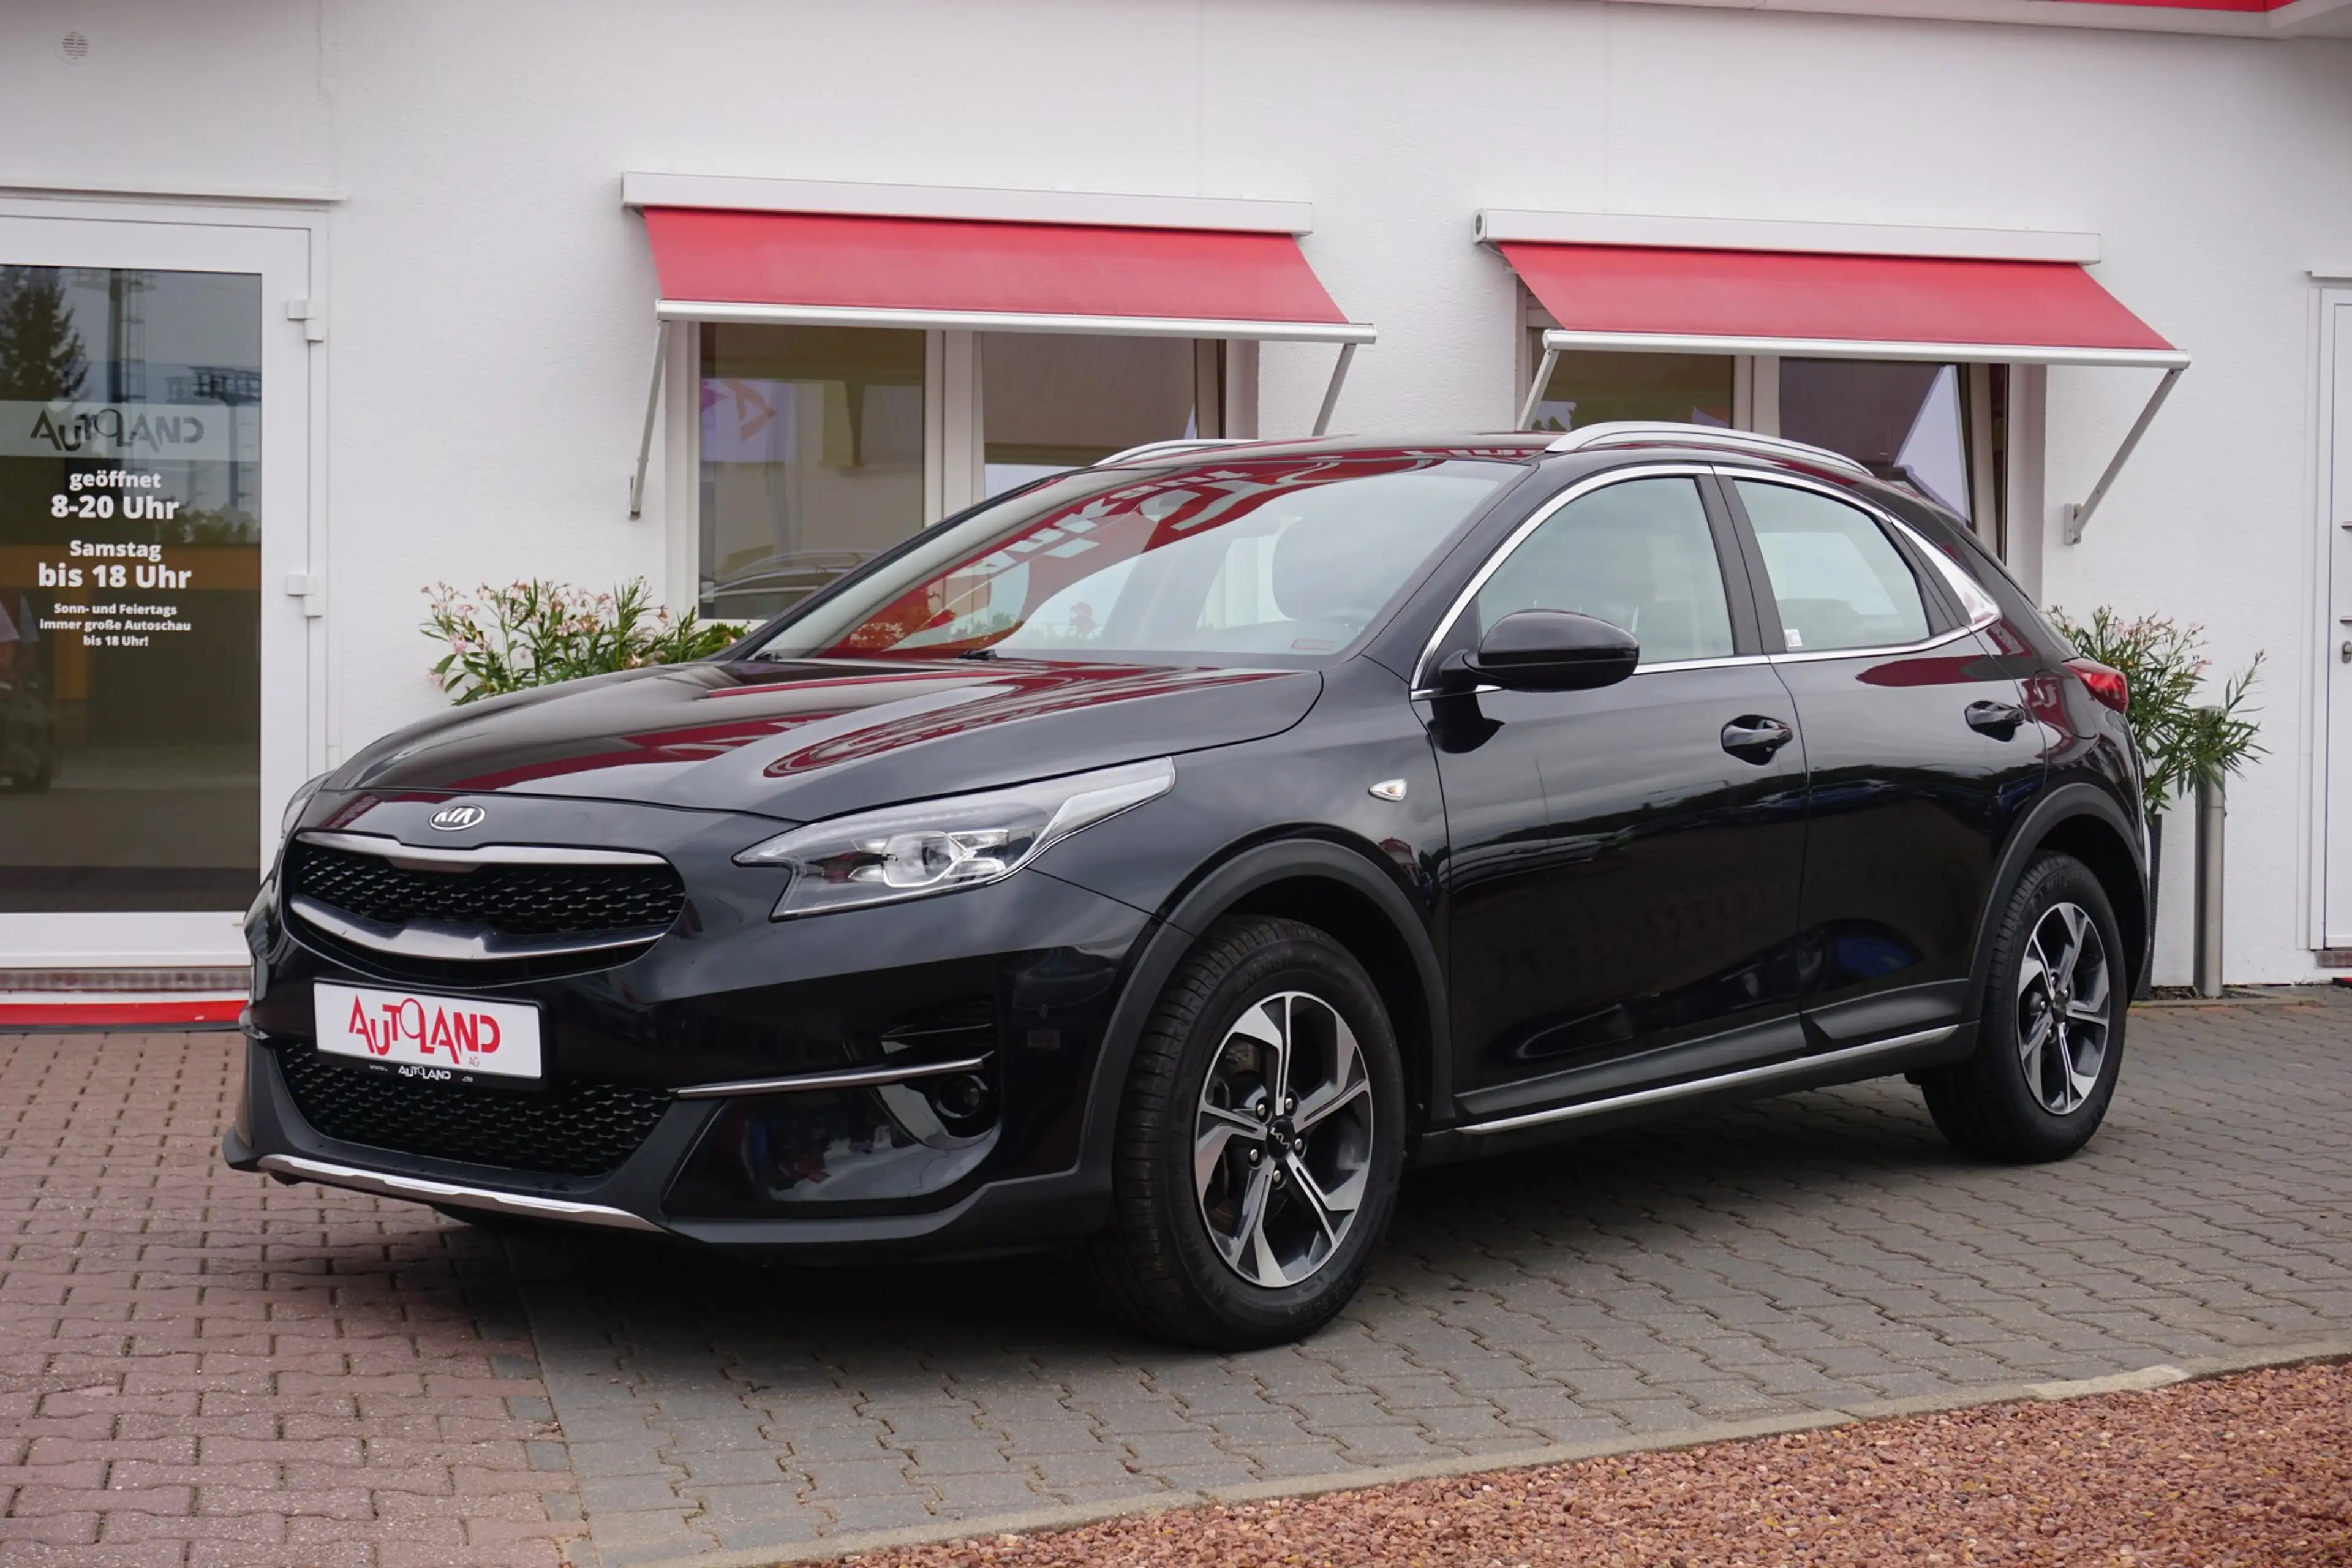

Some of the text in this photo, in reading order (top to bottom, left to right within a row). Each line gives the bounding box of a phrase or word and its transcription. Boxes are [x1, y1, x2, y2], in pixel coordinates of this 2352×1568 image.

[70, 470, 162, 491] geöffnet
[51, 494, 180, 519] 8-20 Uhr
[70, 540, 162, 562] Samstag
[39, 562, 192, 589] bis 18 Uhr
[54, 603, 177, 617] Sonn- und Feiertags
[85, 619, 122, 632] große
[124, 620, 191, 631] Autoschau
[83, 635, 149, 646] bis 18 Uhr!
[348, 994, 501, 1065] AUTOLAND
[468, 1057, 480, 1068] AG
[398, 1065, 451, 1081] AUTOLAND
